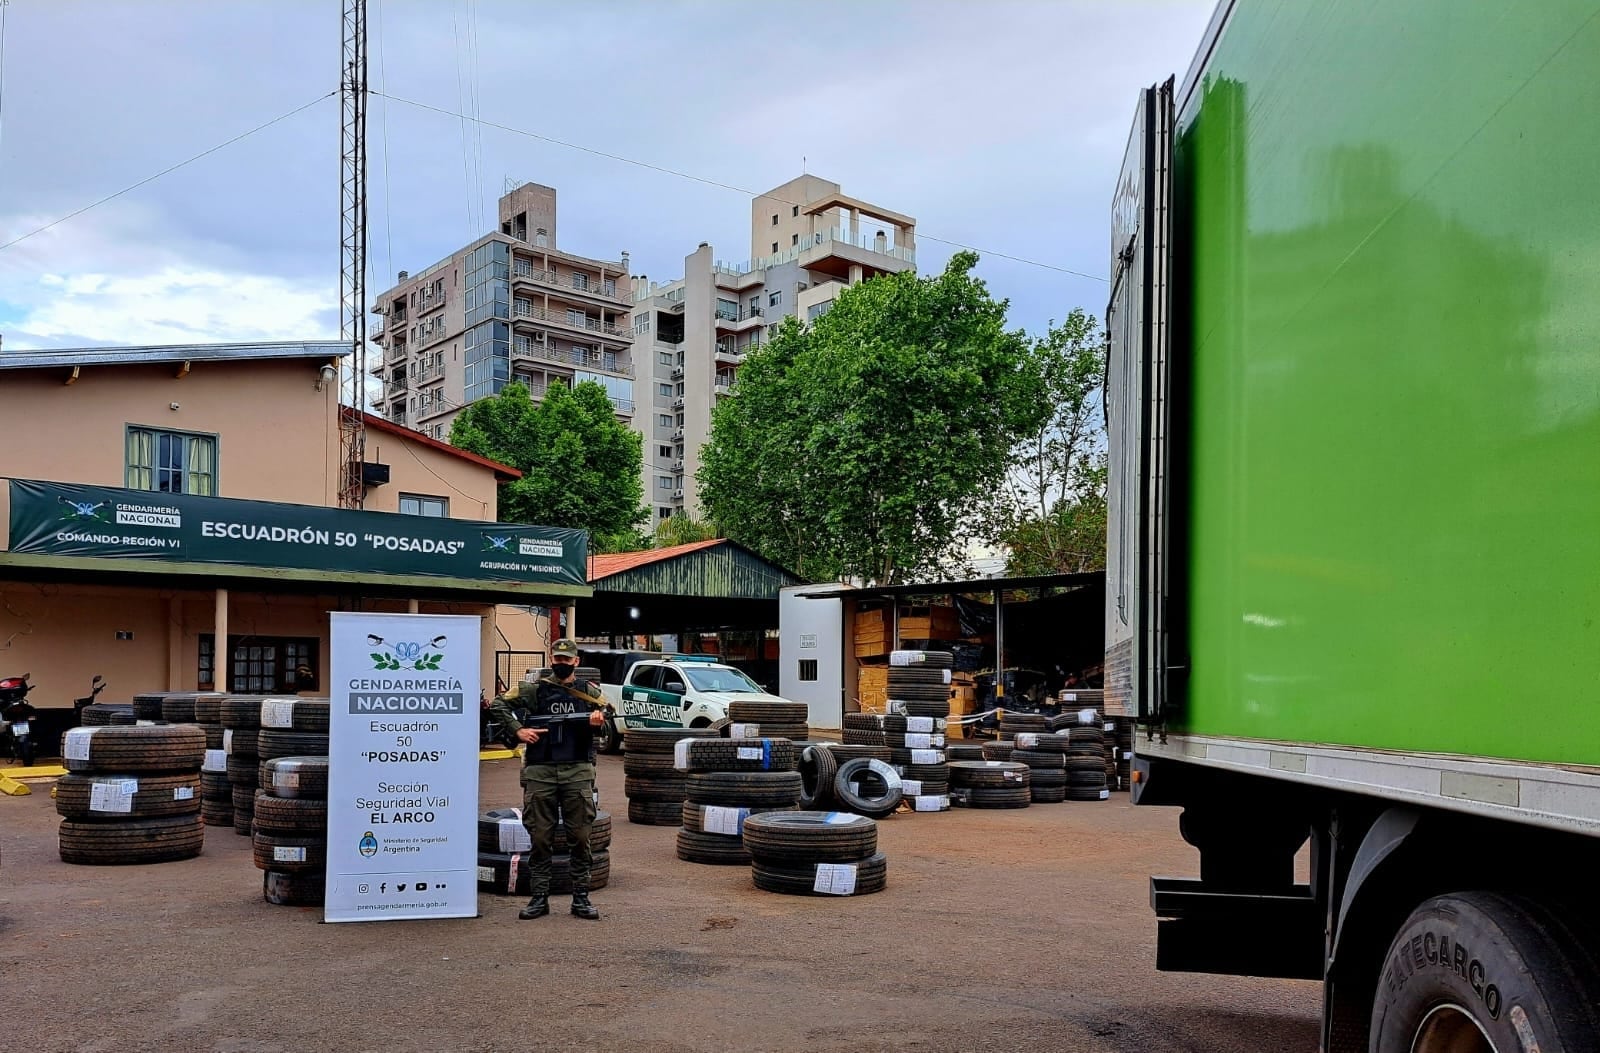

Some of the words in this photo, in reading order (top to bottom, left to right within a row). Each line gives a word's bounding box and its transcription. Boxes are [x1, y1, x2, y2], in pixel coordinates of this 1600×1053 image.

[116, 503, 180, 515] GENDARMERÍA
[120, 514, 177, 526] NACIONAL
[57, 532, 119, 545] COMANDO
[122, 535, 165, 548] REGIÓN
[168, 539, 180, 548] VI
[202, 521, 329, 544] ESCUADRÓN
[334, 531, 357, 547] 50
[519, 537, 562, 546] GENDARMERÍA
[522, 546, 560, 555] NACIONAL
[480, 561, 520, 572] AGRUPACIÓN
[349, 677, 463, 691] GENDARMERÍA
[357, 696, 458, 711] NACIONAL
[550, 702, 575, 714] GNA
[622, 700, 681, 722] GENDARMERIA
[370, 720, 439, 733] Escuadrón
[396, 735, 412, 747] 50
[378, 781, 429, 794] Sección
[356, 797, 422, 812] Seguridad
[426, 796, 450, 808] Vial
[371, 813, 388, 824] EL
[392, 811, 434, 823] ARCO
[383, 846, 420, 855] Argentina
